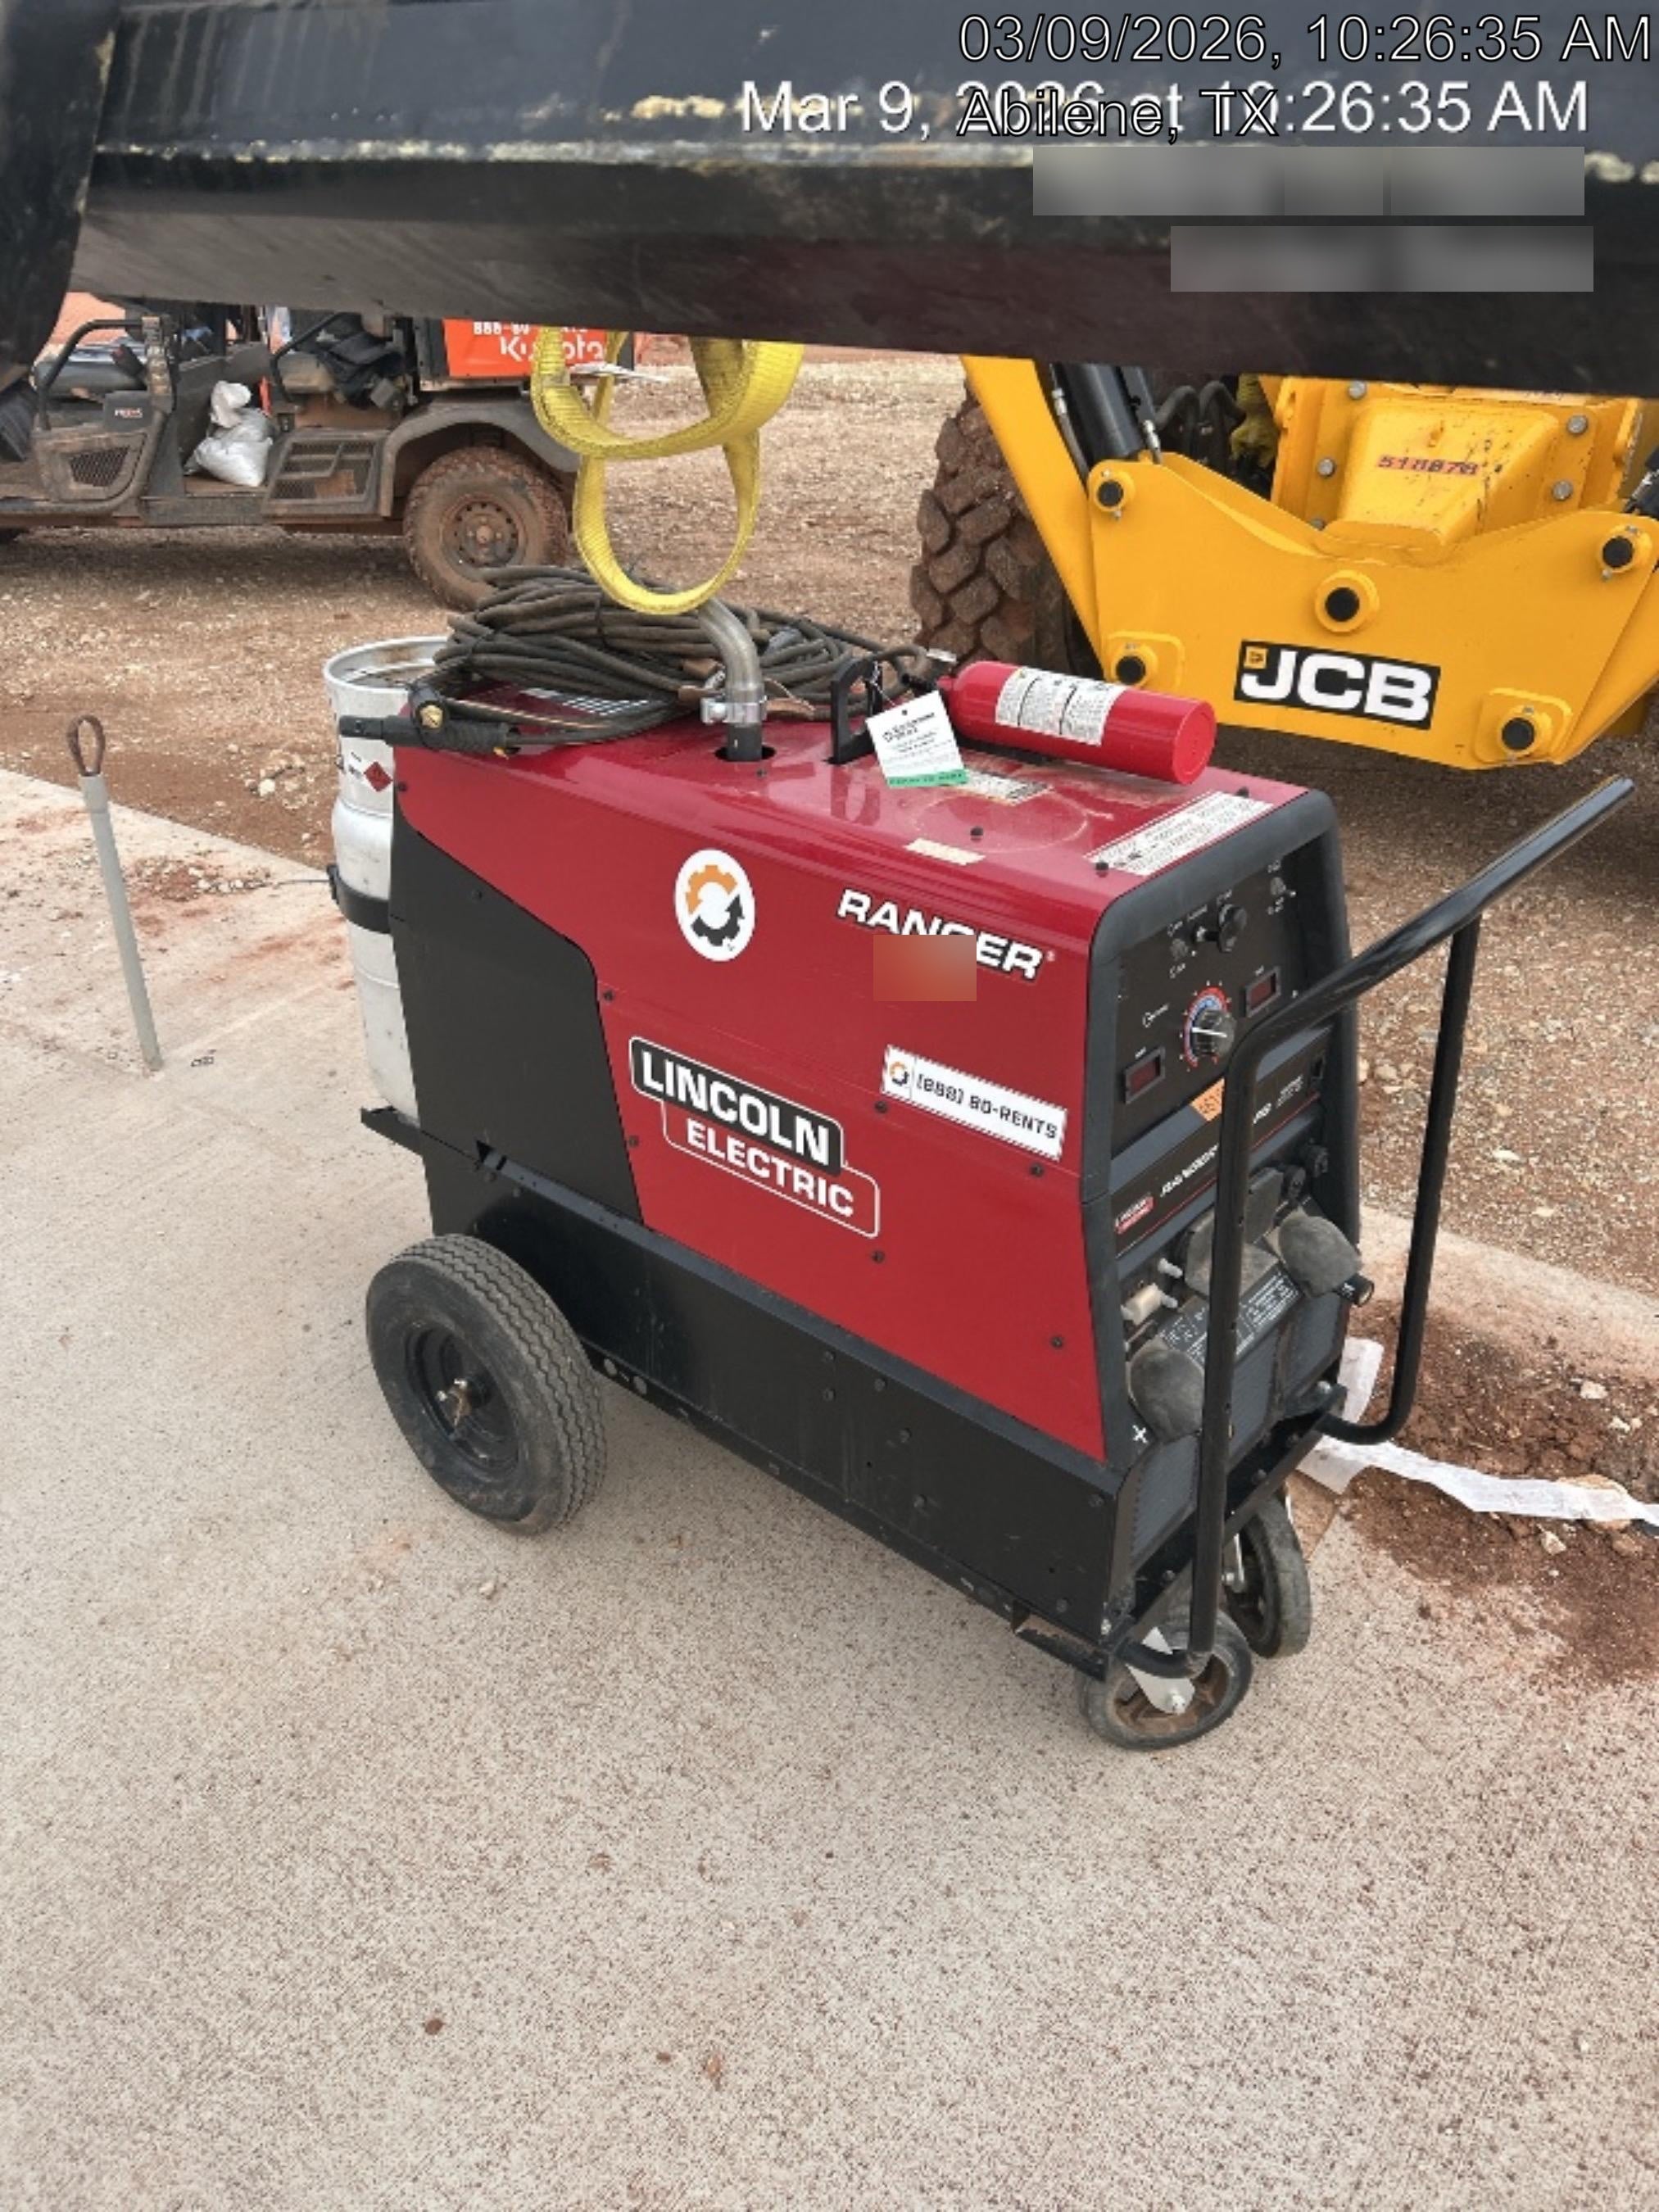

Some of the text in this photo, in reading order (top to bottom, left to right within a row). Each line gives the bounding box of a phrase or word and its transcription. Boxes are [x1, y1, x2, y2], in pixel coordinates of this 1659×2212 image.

[1240, 649, 1432, 721] JCB
[642, 1050, 829, 1166] LINCOLN
[687, 1117, 854, 1217] ELECTRIC
